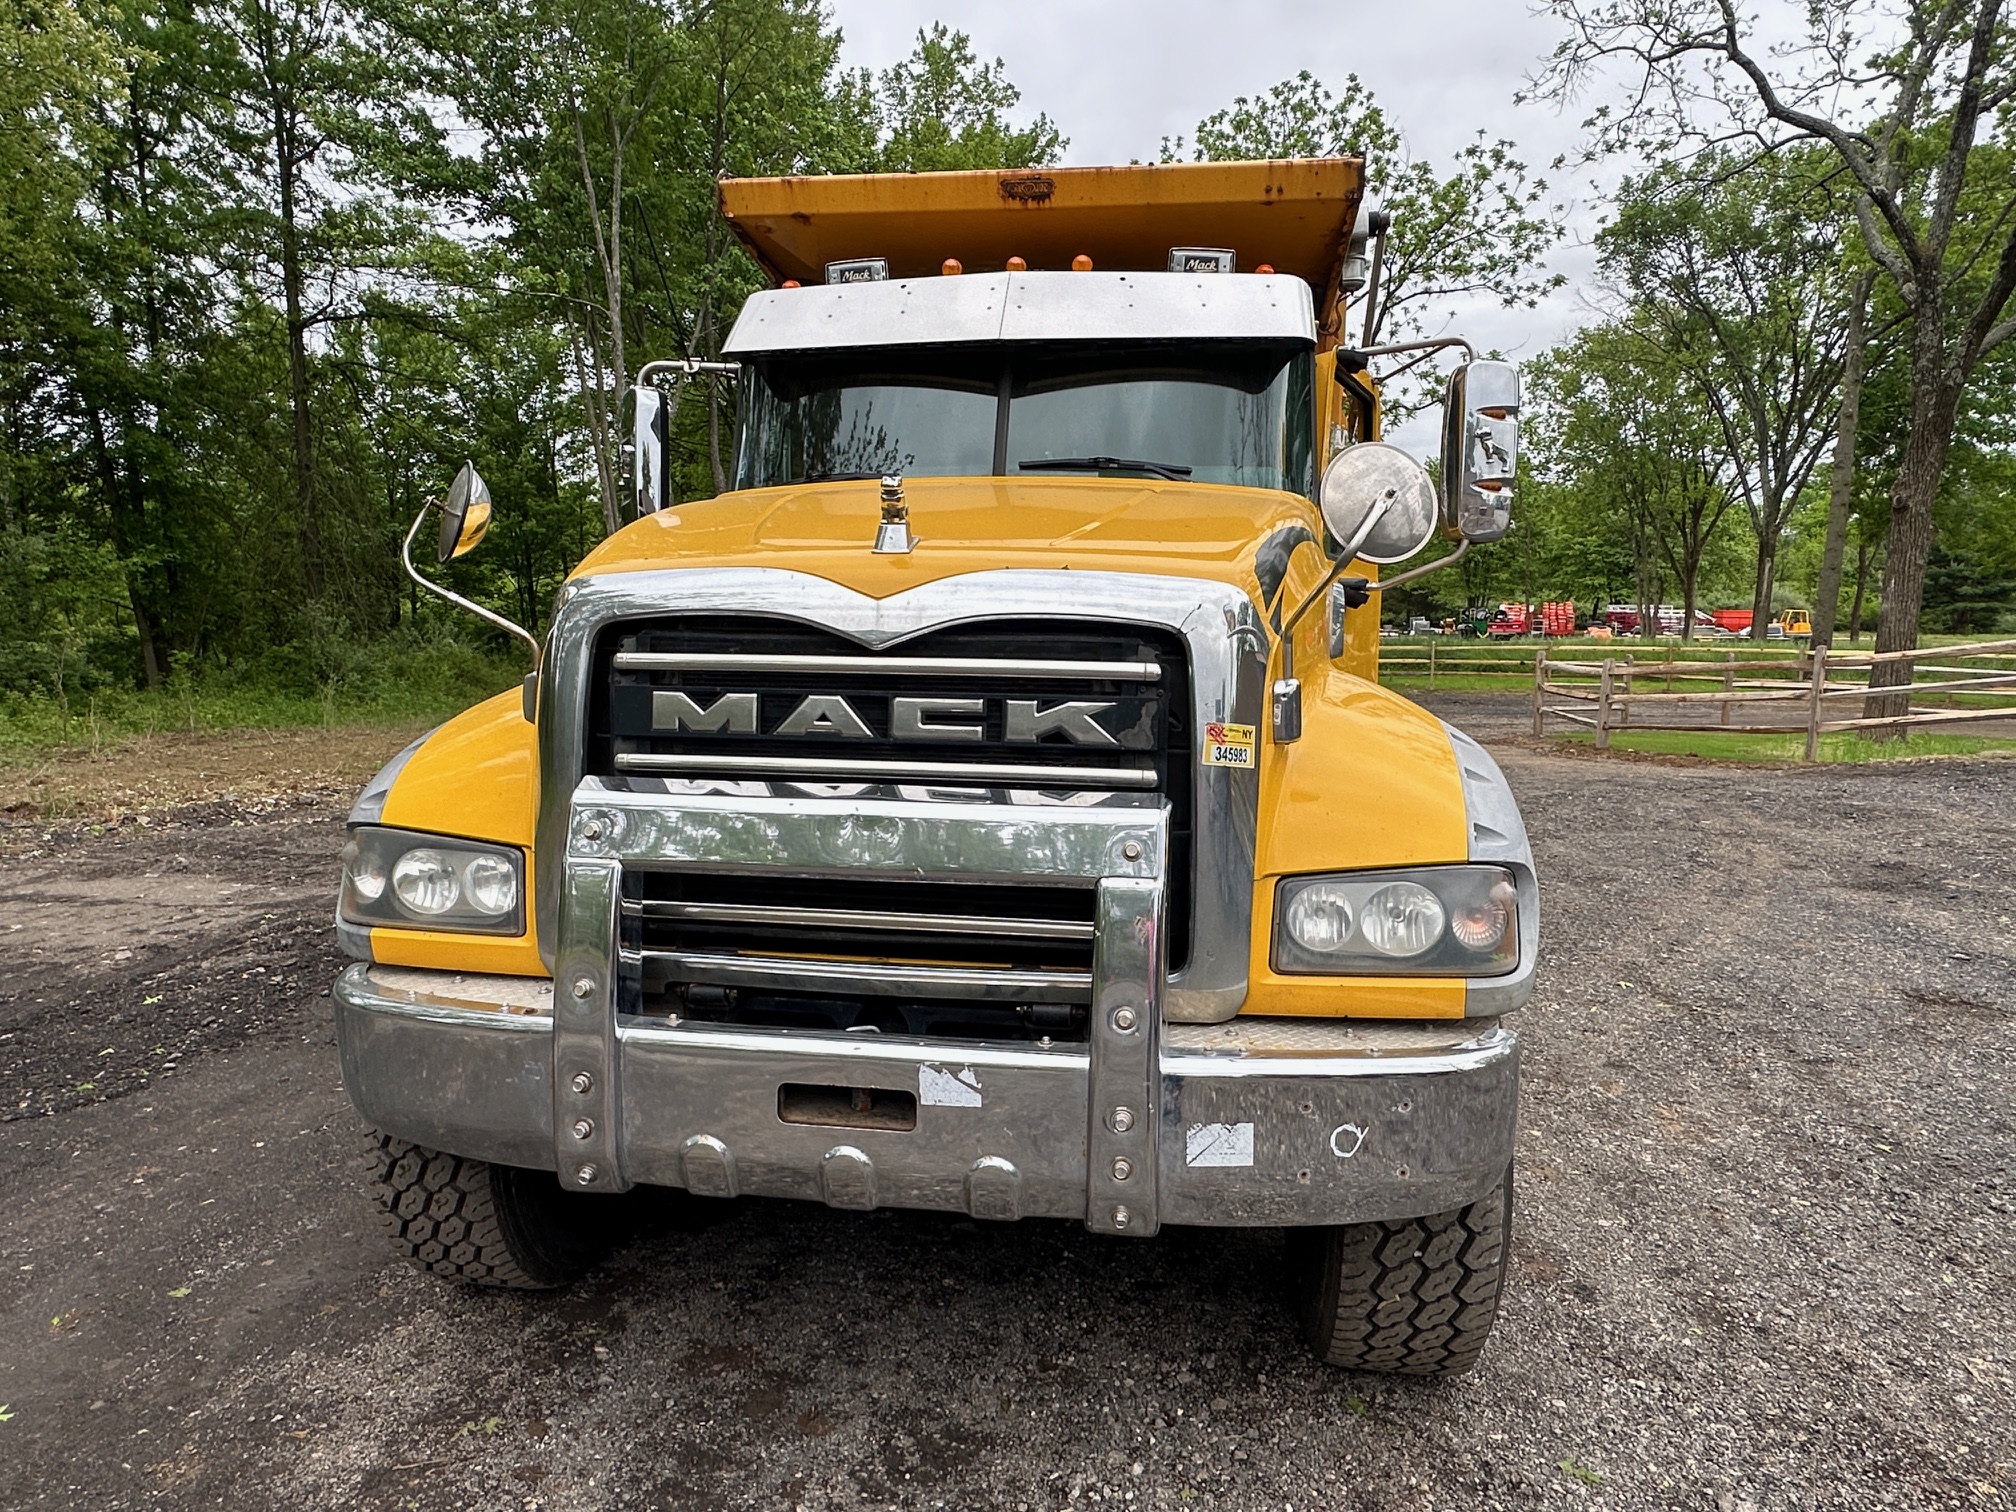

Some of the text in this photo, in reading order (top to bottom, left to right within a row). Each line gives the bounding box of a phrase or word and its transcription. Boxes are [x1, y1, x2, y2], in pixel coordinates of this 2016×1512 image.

[1185, 259, 1217, 271] Mack
[841, 269, 871, 282] Mack
[652, 690, 1120, 745] MACK
[1241, 729, 1253, 740] NY
[1215, 746, 1247, 763] 345983
